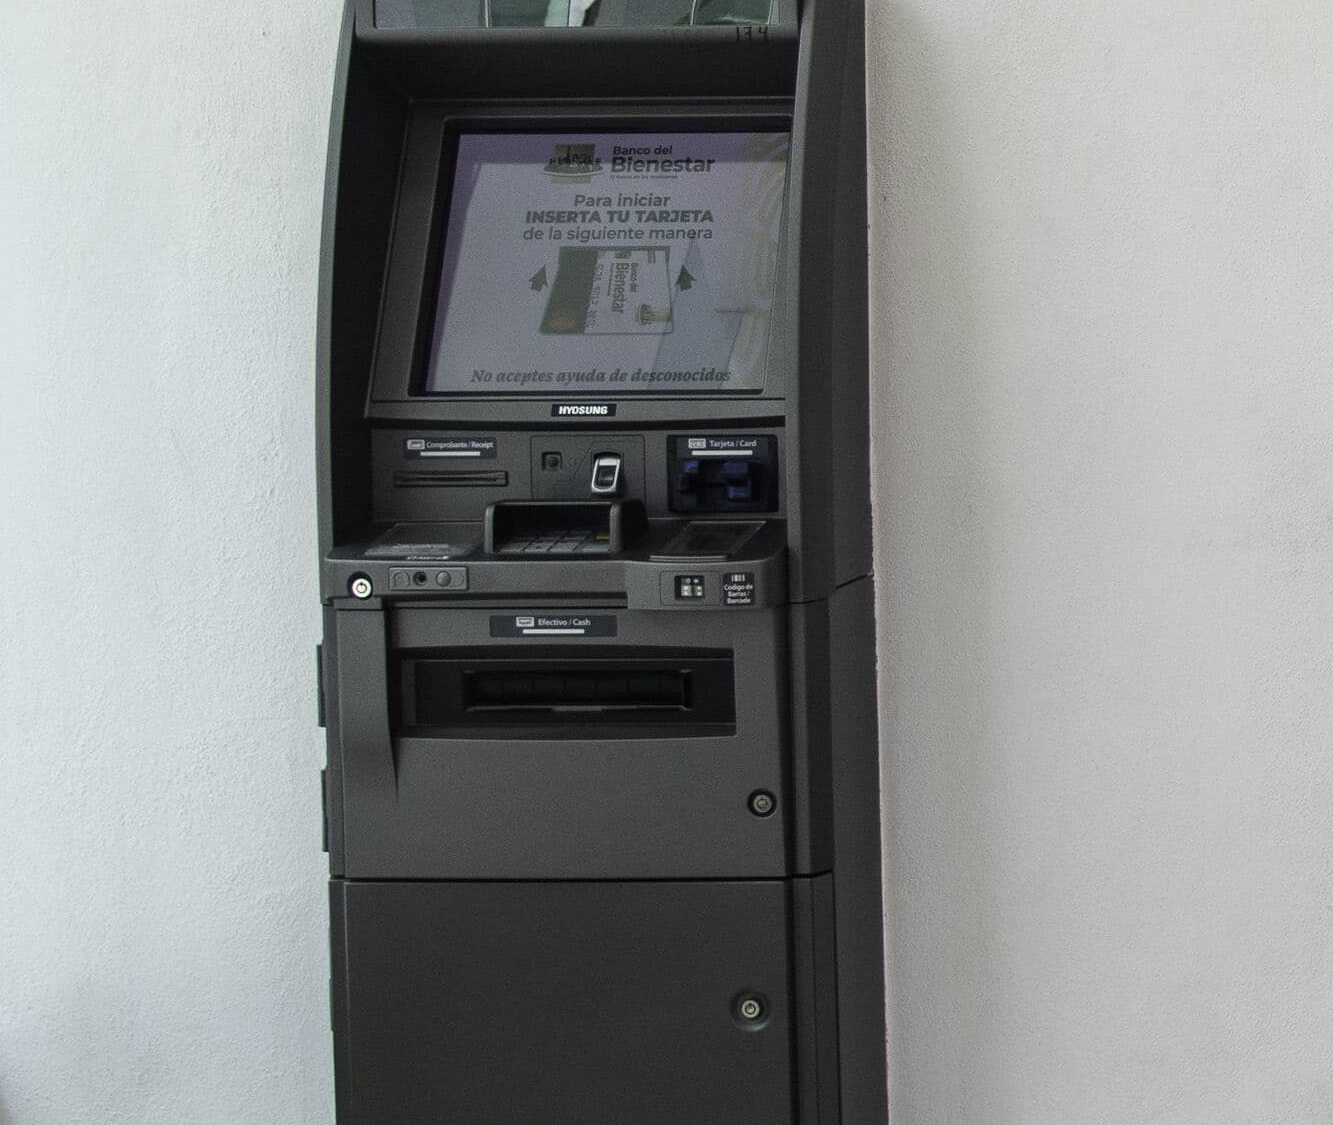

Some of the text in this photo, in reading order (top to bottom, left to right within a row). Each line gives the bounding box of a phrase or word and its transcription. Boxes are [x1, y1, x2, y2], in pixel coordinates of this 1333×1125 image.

[613, 145, 672, 156] Banco del
[611, 157, 715, 173] Bienestar
[574, 193, 671, 207] Para iniciar
[526, 210, 714, 224] INSERTA TU TARJETA
[523, 226, 713, 243] de la siguiente manera
[611, 263, 629, 314] Bienestar
[471, 367, 731, 386] No aceptes ayuda de desconocidos
[558, 406, 608, 415] HYOSUNG
[709, 440, 734, 449] Tarjeta
[538, 618, 567, 626] Efectivo
[572, 618, 591, 626] Cash
